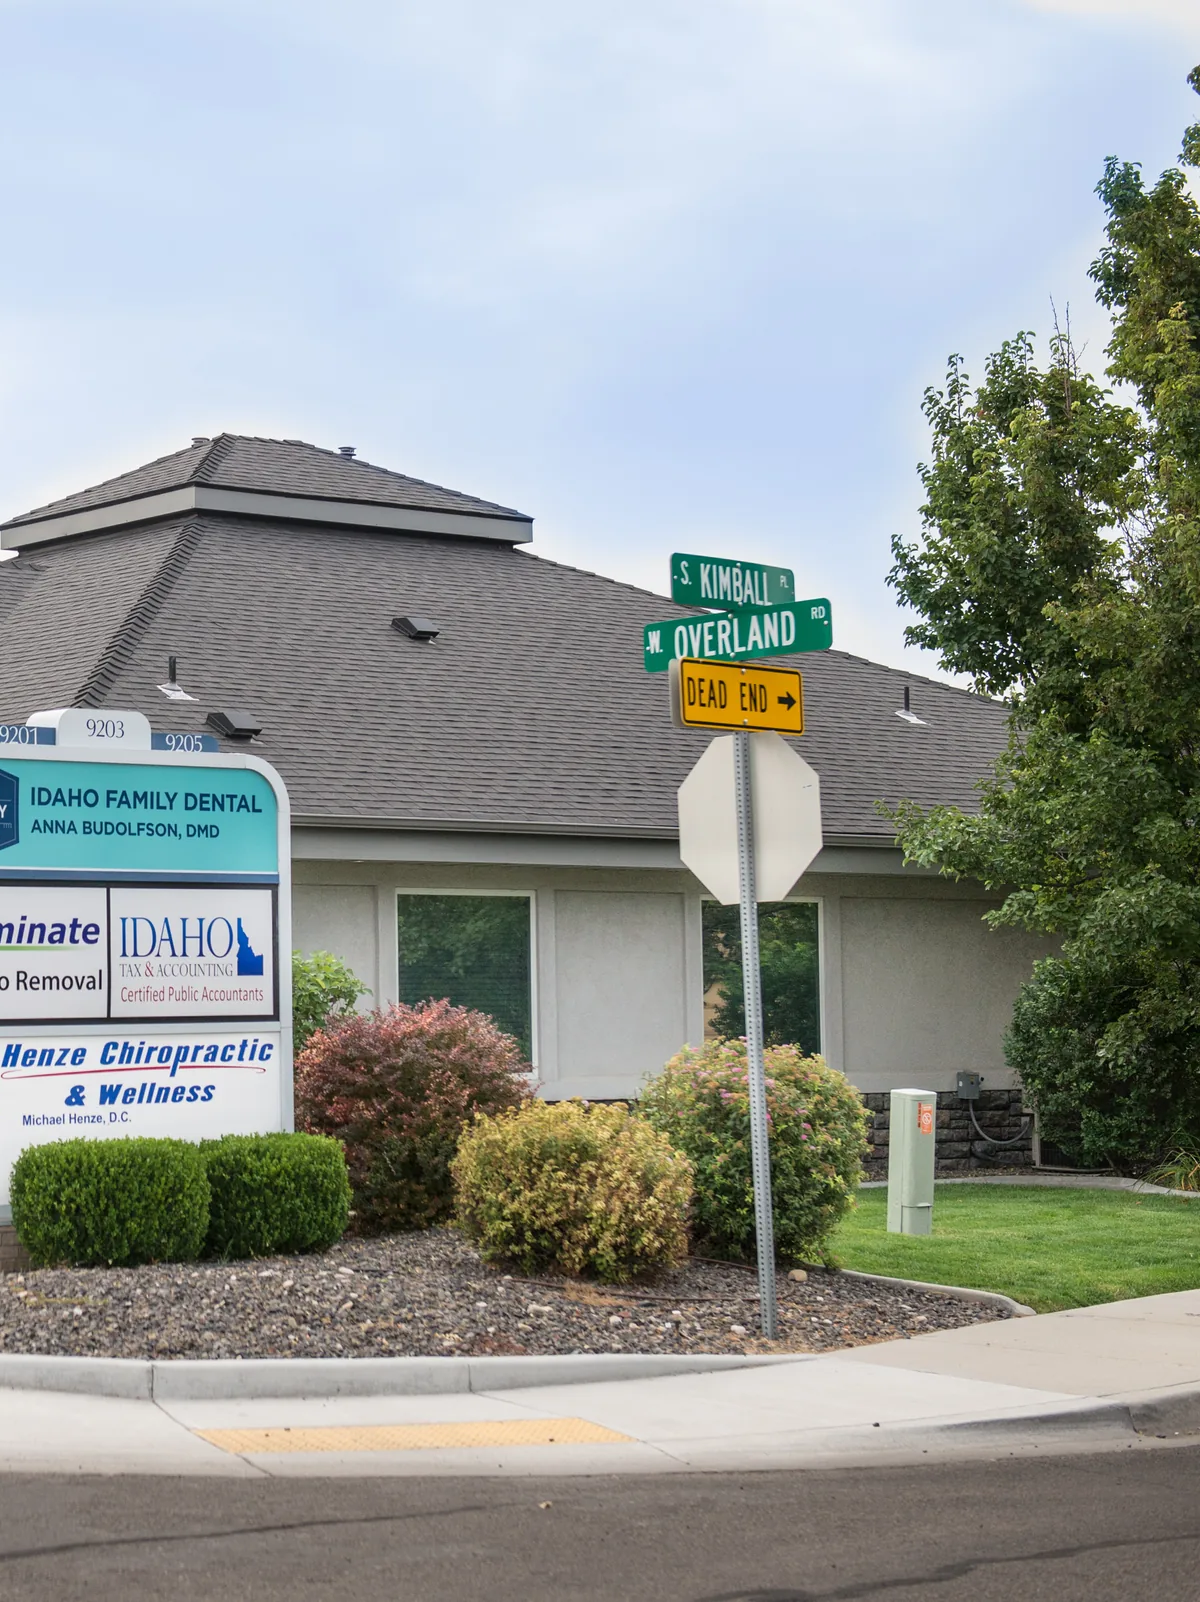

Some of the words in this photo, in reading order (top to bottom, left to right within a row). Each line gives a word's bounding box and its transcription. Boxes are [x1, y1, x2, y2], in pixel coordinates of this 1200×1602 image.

[680, 561, 692, 585] S.
[700, 563, 773, 606] KIMBALL
[780, 575, 789, 588] PL
[648, 630, 663, 654] W.
[674, 610, 796, 659] OVERLAND
[811, 606, 826, 620] RD
[687, 677, 727, 709] DEAD
[740, 682, 767, 713] END
[0, 725, 39, 744] 9201
[86, 719, 125, 738] 9203
[165, 734, 203, 752] 9205
[30, 787, 99, 808] IDAHO
[105, 789, 178, 811] FAMILY
[184, 792, 263, 813] DENTAL
[30, 819, 78, 835] ANNA
[82, 820, 182, 840] BUDOLFSON,
[186, 824, 220, 838] DMD
[119, 917, 234, 958] IDAHO
[16, 969, 103, 991] Removal
[119, 963, 142, 977] TAX
[144, 961, 154, 977] &
[156, 963, 233, 977] ACCOUNTING
[121, 985, 165, 1002] Certified
[168, 985, 199, 1002] Public
[201, 986, 264, 1002] Accountants
[1, 1043, 87, 1068] Henze
[99, 1039, 274, 1077] Chiropractic
[64, 1084, 85, 1107] &
[99, 1082, 216, 1105] Wellness
[22, 1113, 65, 1126] Michael
[68, 1112, 106, 1125] Henze,
[109, 1111, 132, 1123] D.C.
